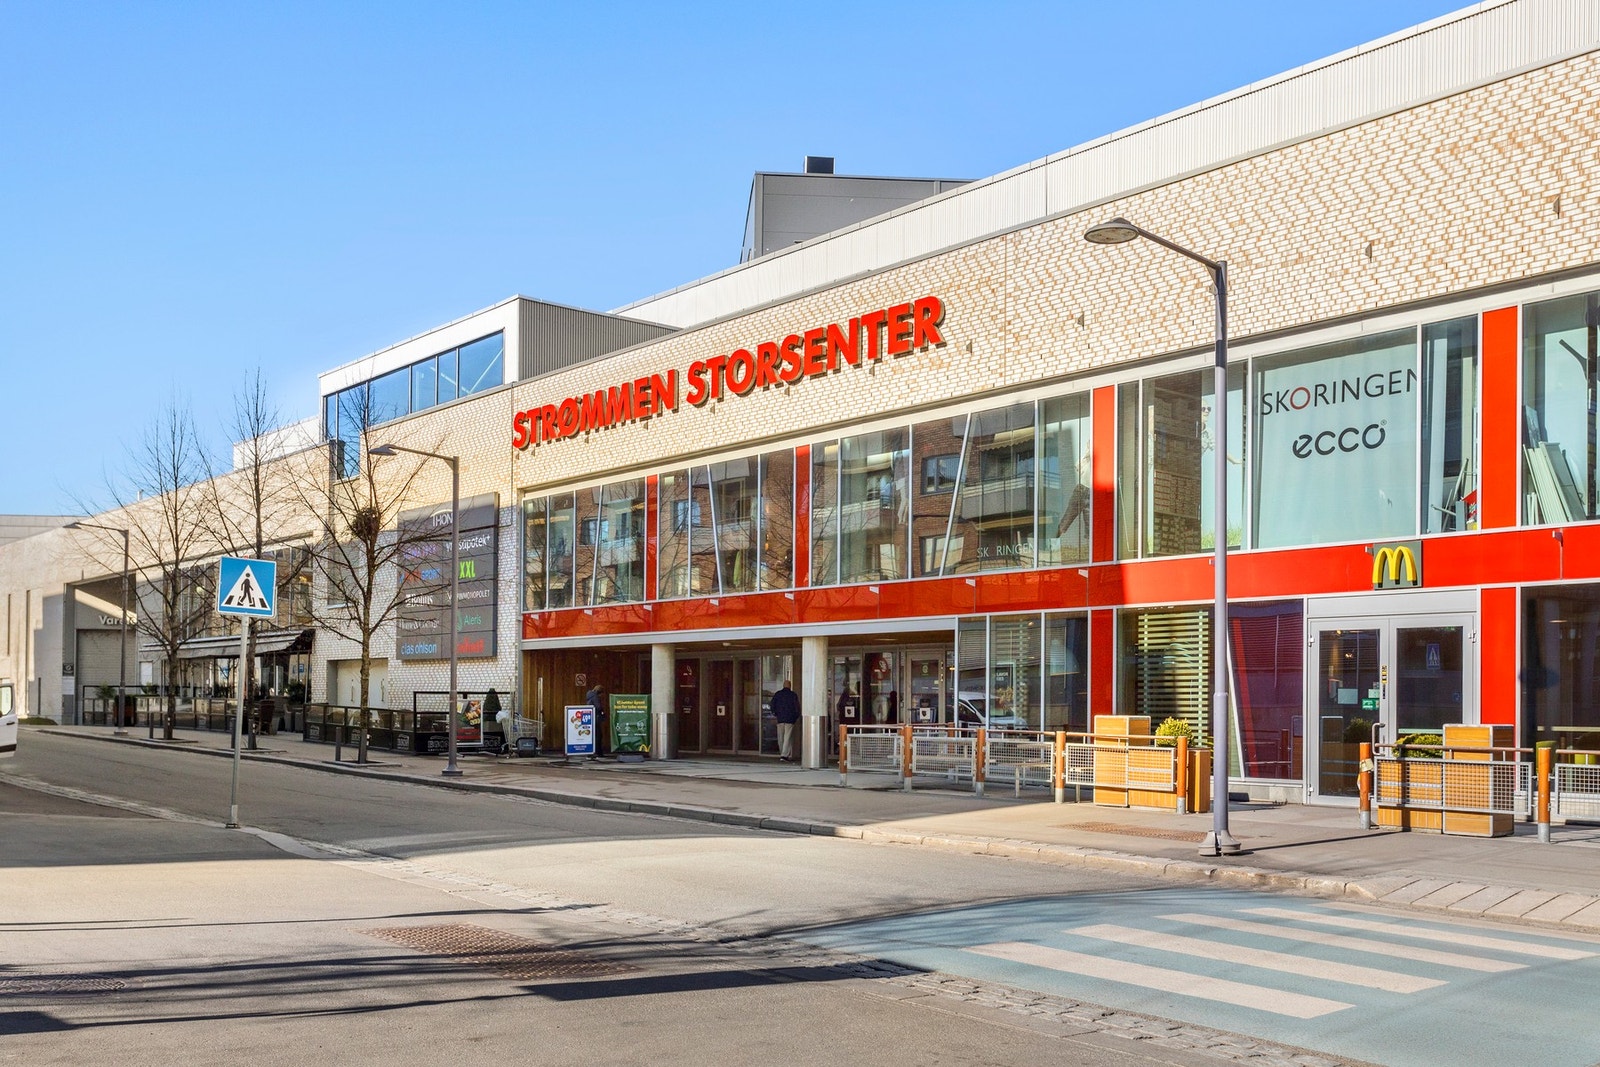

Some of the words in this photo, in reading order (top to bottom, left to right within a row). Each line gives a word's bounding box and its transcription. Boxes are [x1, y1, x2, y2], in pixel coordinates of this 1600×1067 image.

[512, 369, 678, 450] STRØMMEN
[687, 295, 945, 407] STORSENTER
[1261, 368, 1418, 416] SKORINGEN
[1292, 423, 1386, 459] ecco
[430, 513, 453, 527] THON
[459, 559, 476, 579] XXL
[464, 614, 482, 625] Aleris
[414, 641, 437, 655] ohlson
